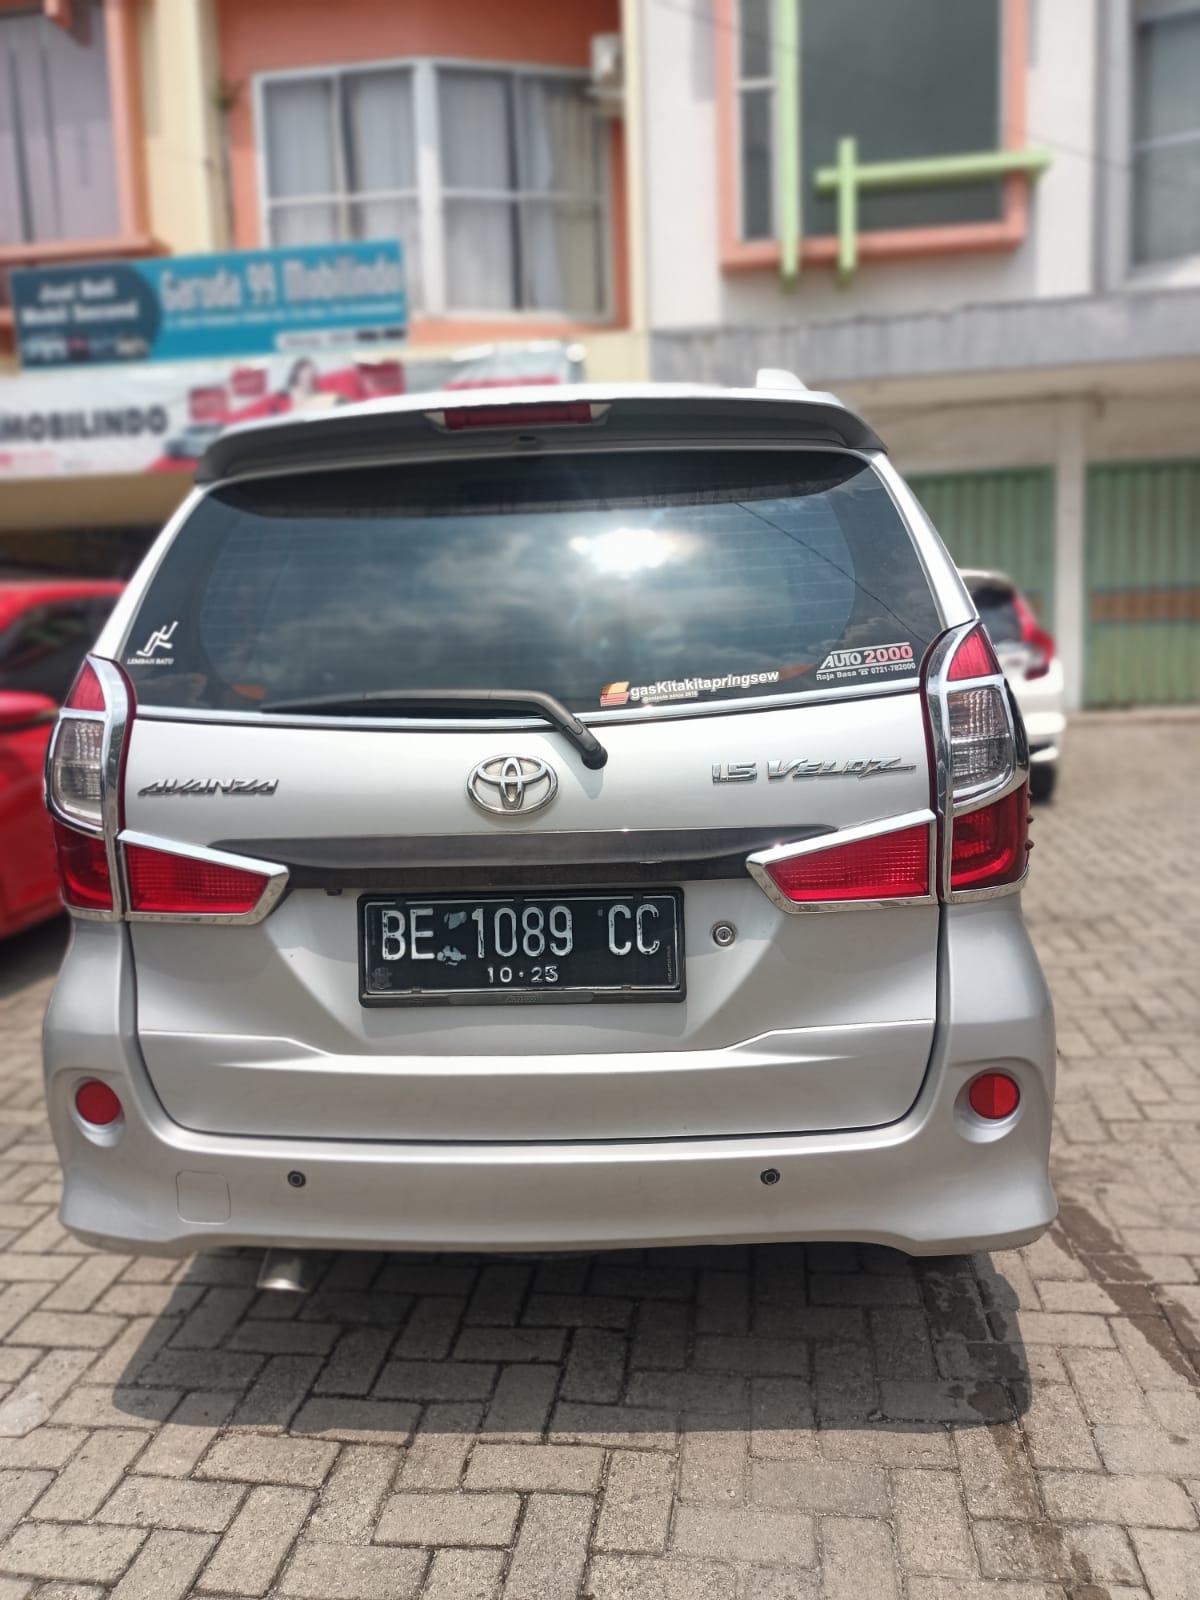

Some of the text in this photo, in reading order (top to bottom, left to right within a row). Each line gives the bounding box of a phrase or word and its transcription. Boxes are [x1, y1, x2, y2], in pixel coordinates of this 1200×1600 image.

[820, 646, 913, 669] AUTO 2000
[137, 778, 279, 797] AVANZA
[381, 904, 660, 961] BE 1089 CC
